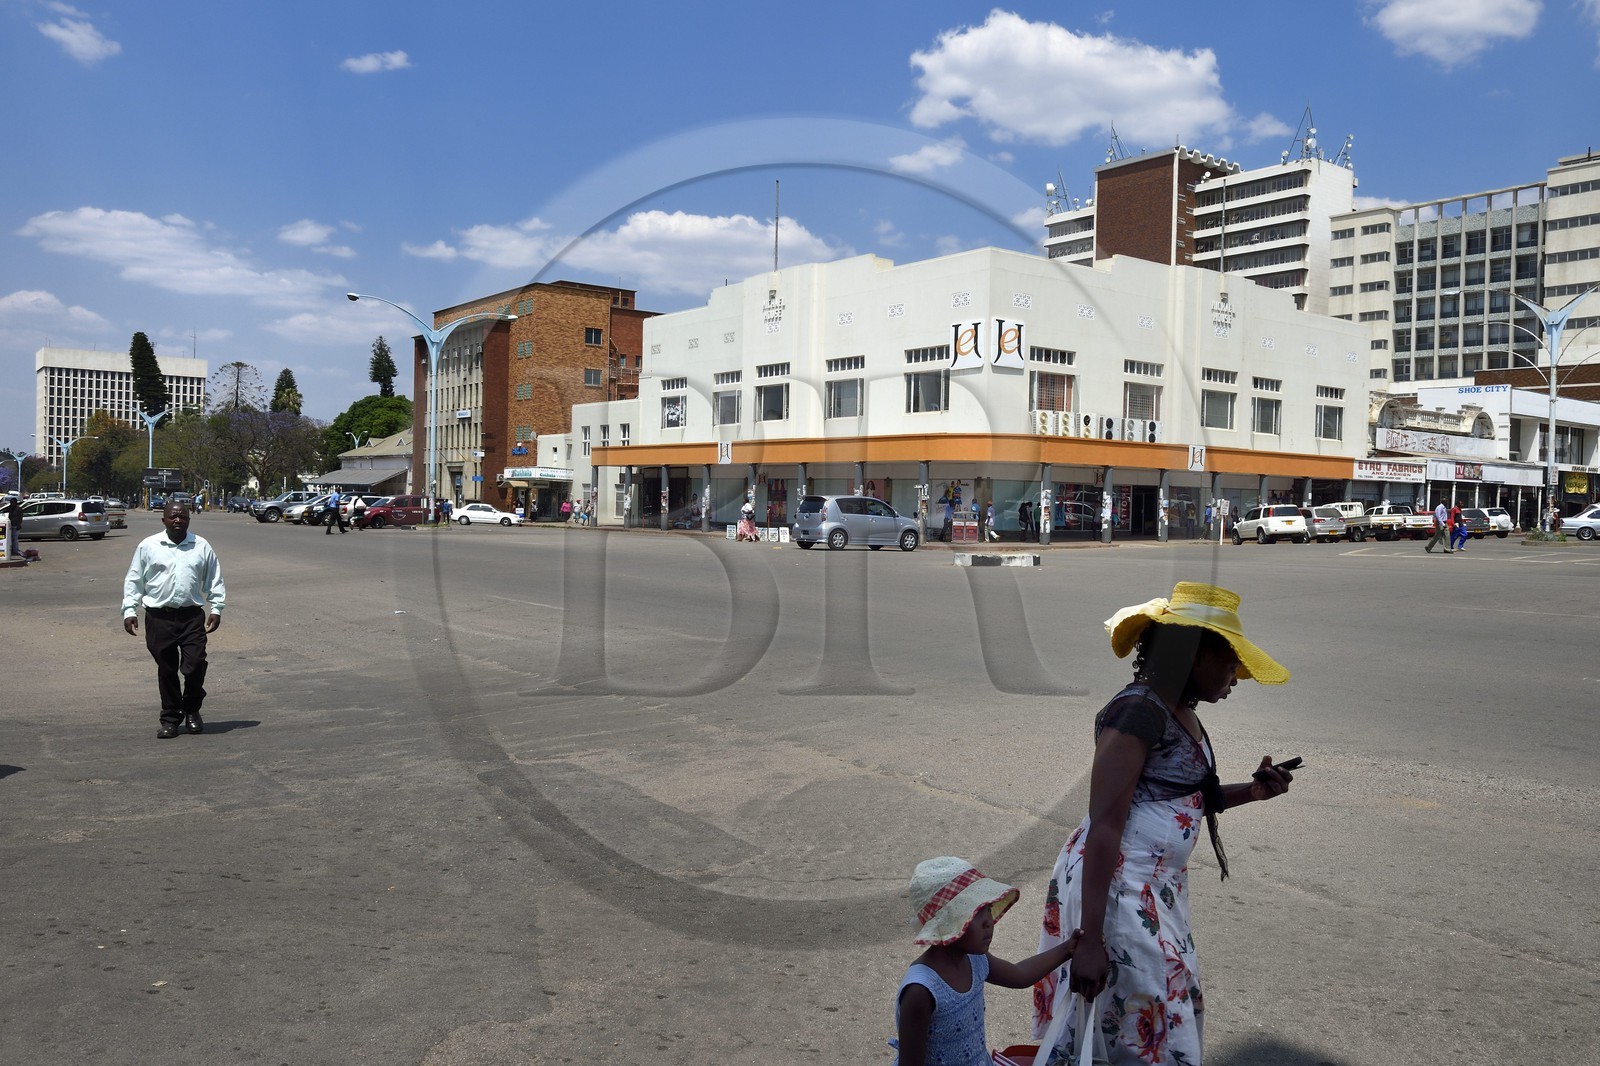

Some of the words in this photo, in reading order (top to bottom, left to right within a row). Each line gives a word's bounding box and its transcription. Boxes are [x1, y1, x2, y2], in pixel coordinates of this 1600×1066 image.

[1458, 386, 1482, 394] SHOE
[1484, 385, 1509, 393] CITY
[1387, 464, 1423, 474] FABRICS
